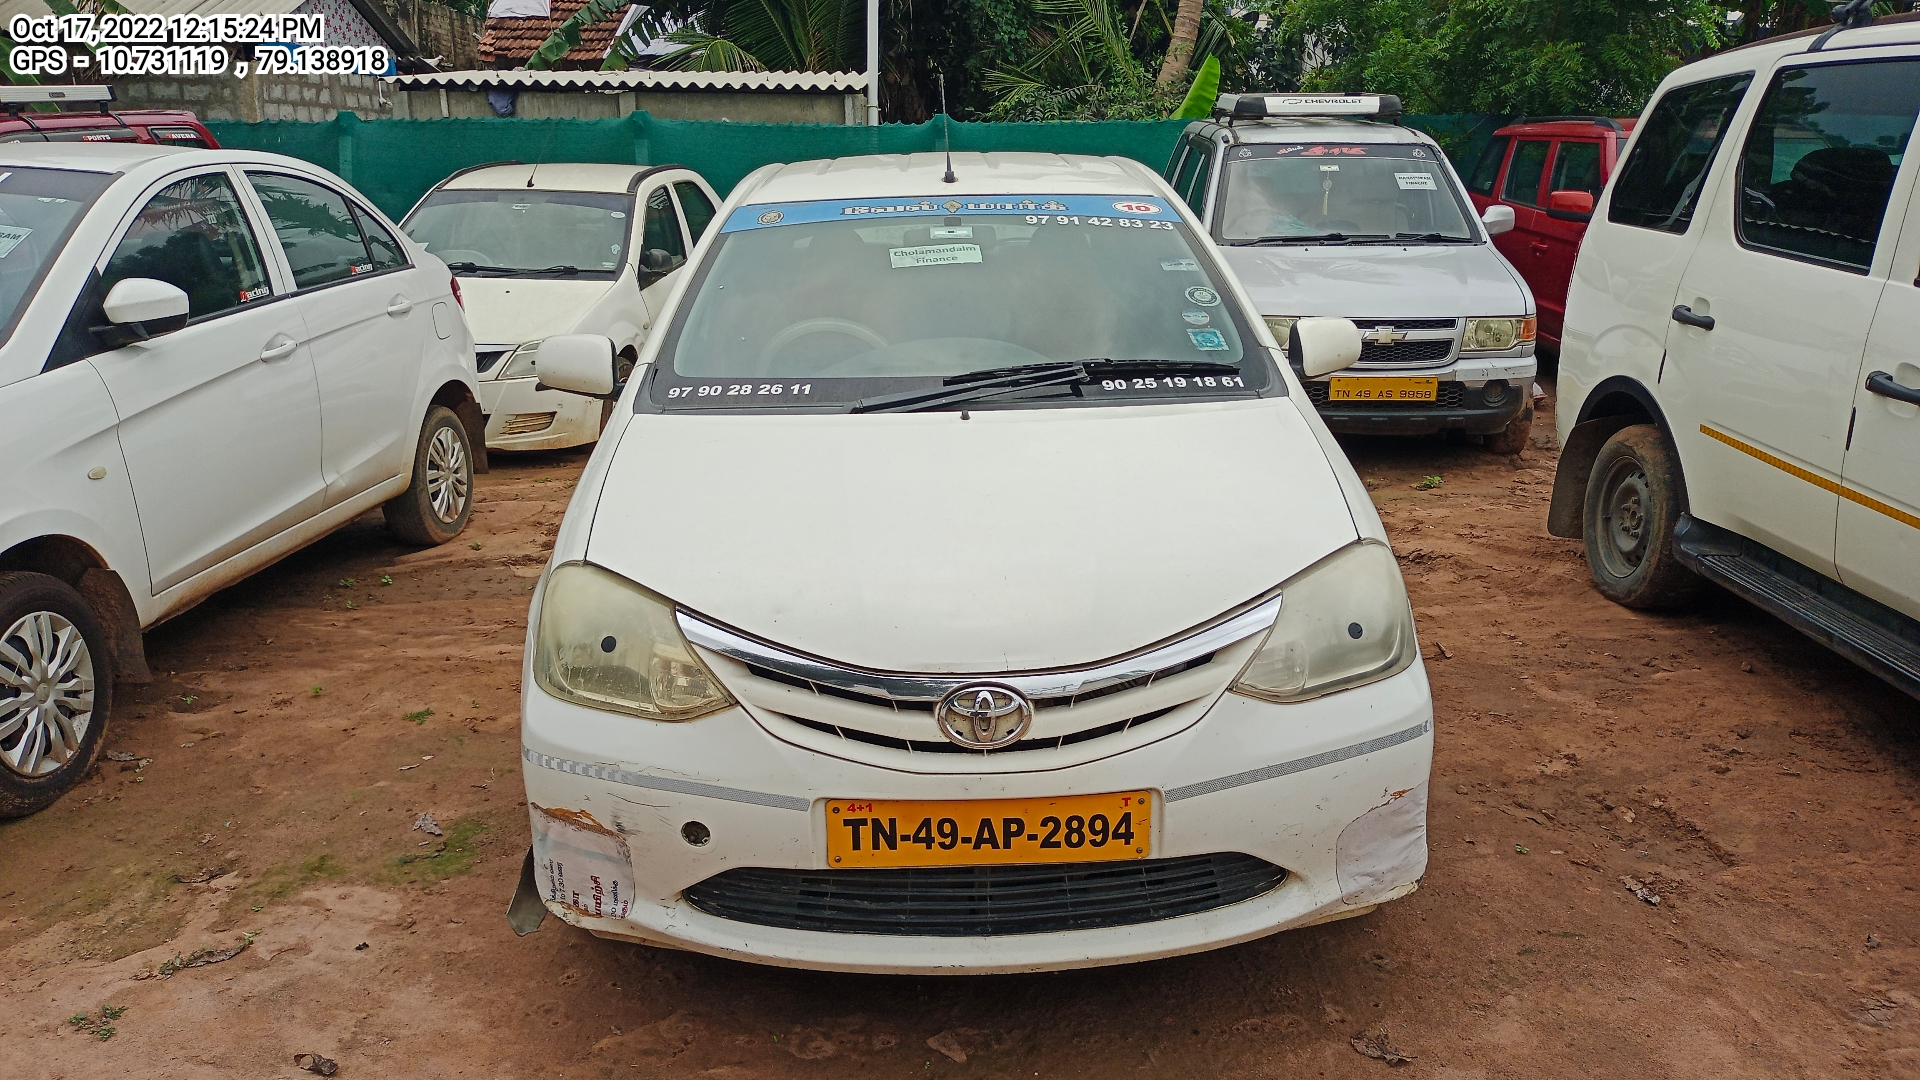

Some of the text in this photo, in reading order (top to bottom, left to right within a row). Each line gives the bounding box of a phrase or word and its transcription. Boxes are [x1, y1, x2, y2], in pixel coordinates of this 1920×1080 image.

[1127, 203, 1151, 212] 10
[1025, 215, 1174, 231] 97 91 42 83 23
[916, 255, 959, 264] Finance
[1101, 376, 1245, 391] 90 25 19 18 61
[667, 383, 812, 398] 97 90 28 26 11
[1335, 389, 1350, 398] TN
[1355, 389, 1371, 398] 49
[1377, 389, 1393, 398] AS
[846, 802, 873, 813] 4+1
[1121, 797, 1131, 807] T
[842, 811, 1135, 852] TN-49-AP-2894
